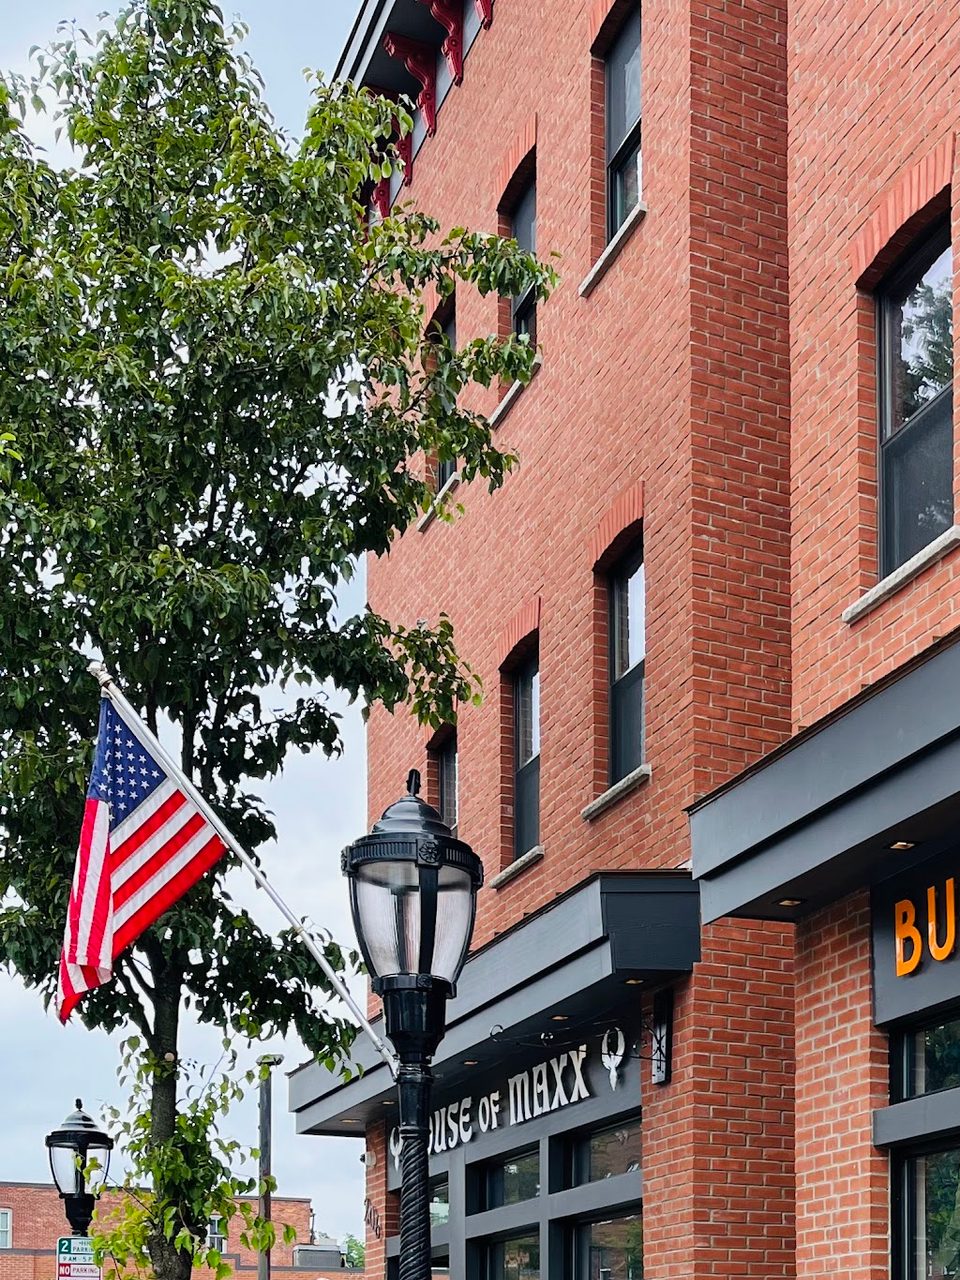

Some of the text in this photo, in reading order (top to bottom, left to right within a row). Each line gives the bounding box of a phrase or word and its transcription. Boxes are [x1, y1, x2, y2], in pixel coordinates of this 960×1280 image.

[427, 1043, 590, 1156] USE OF MAXX
[61, 1240, 69, 1251] 2
[60, 1266, 70, 1275] NO
